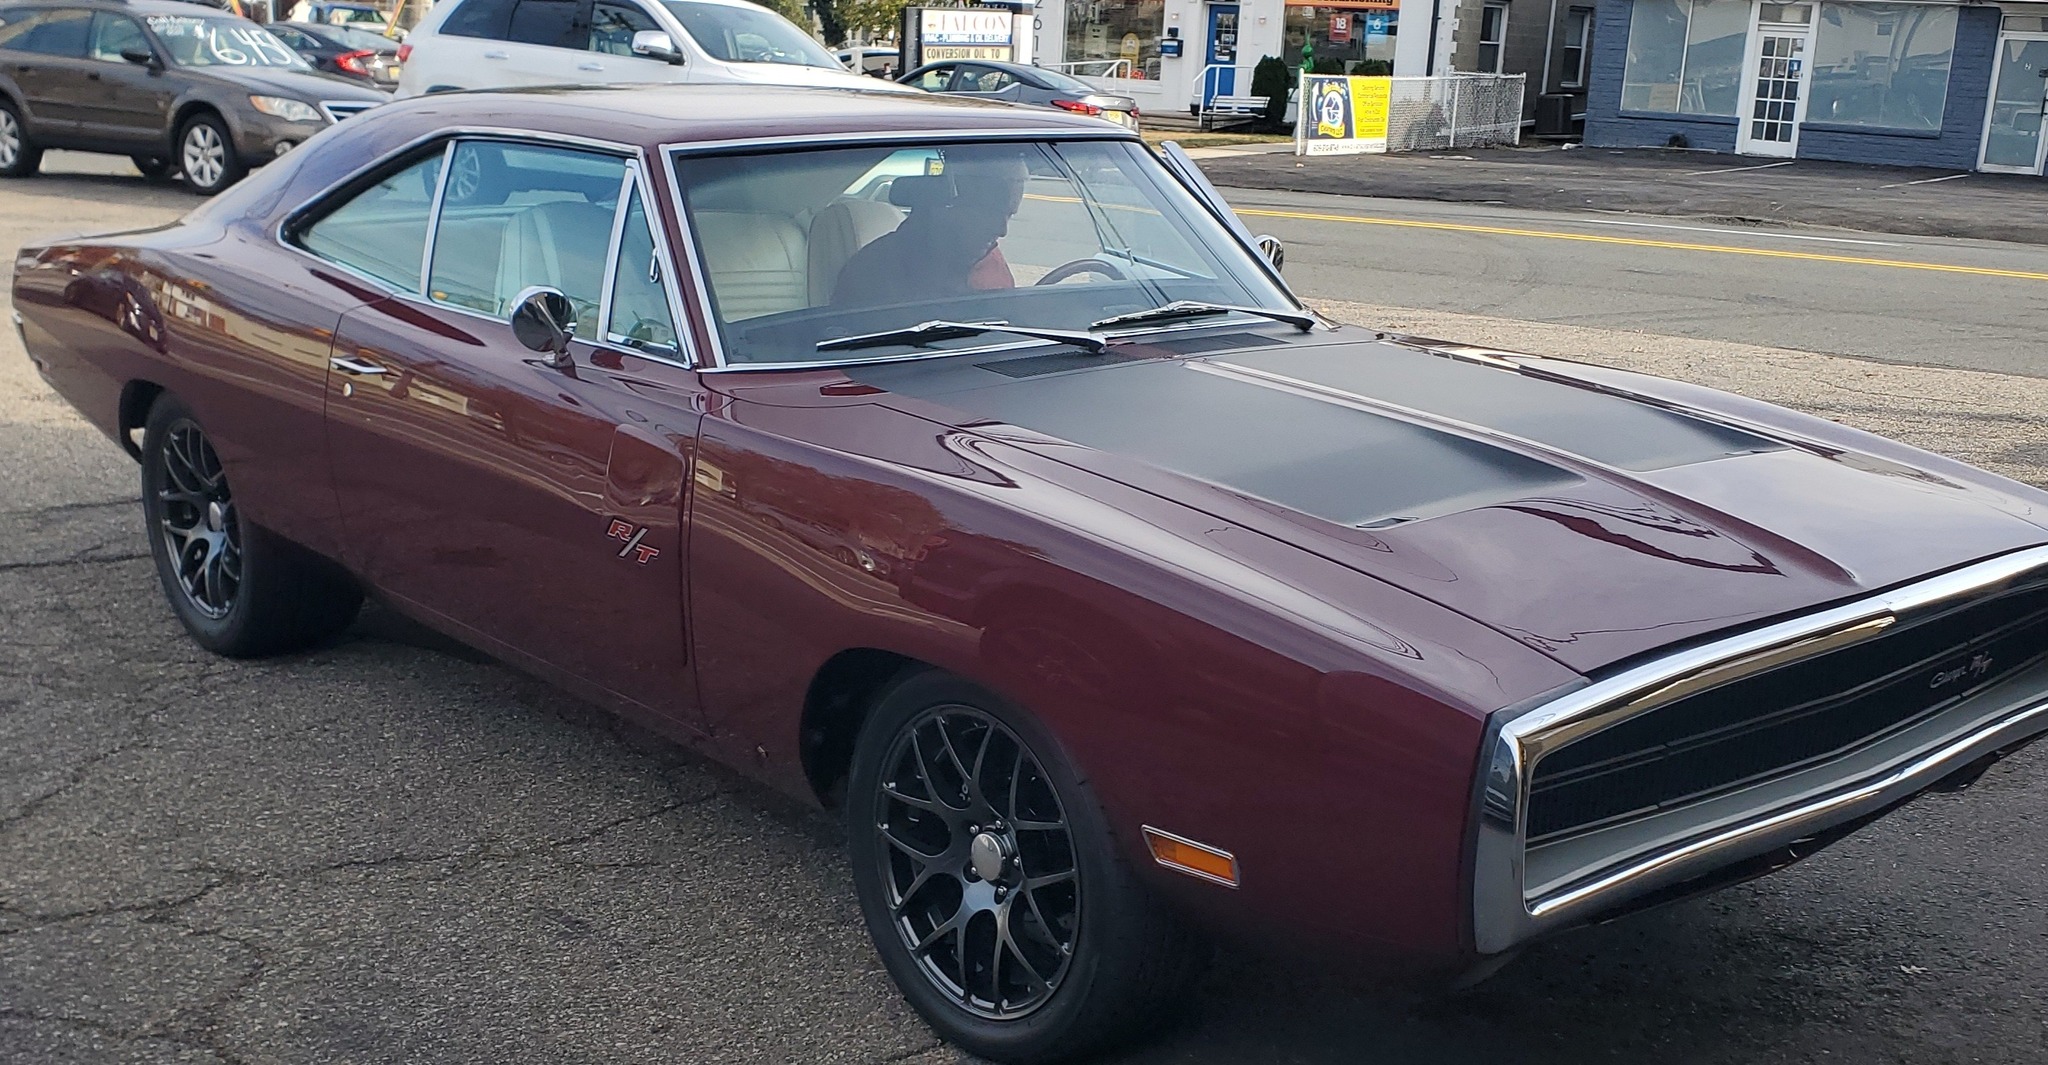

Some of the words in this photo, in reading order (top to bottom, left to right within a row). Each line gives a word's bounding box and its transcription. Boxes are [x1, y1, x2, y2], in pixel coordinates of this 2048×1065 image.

[1335, 18, 1346, 29] 18
[926, 48, 971, 59] CONVERSION
[974, 48, 986, 59] OIL
[991, 48, 1001, 59] TO
[607, 519, 660, 564] R/T
